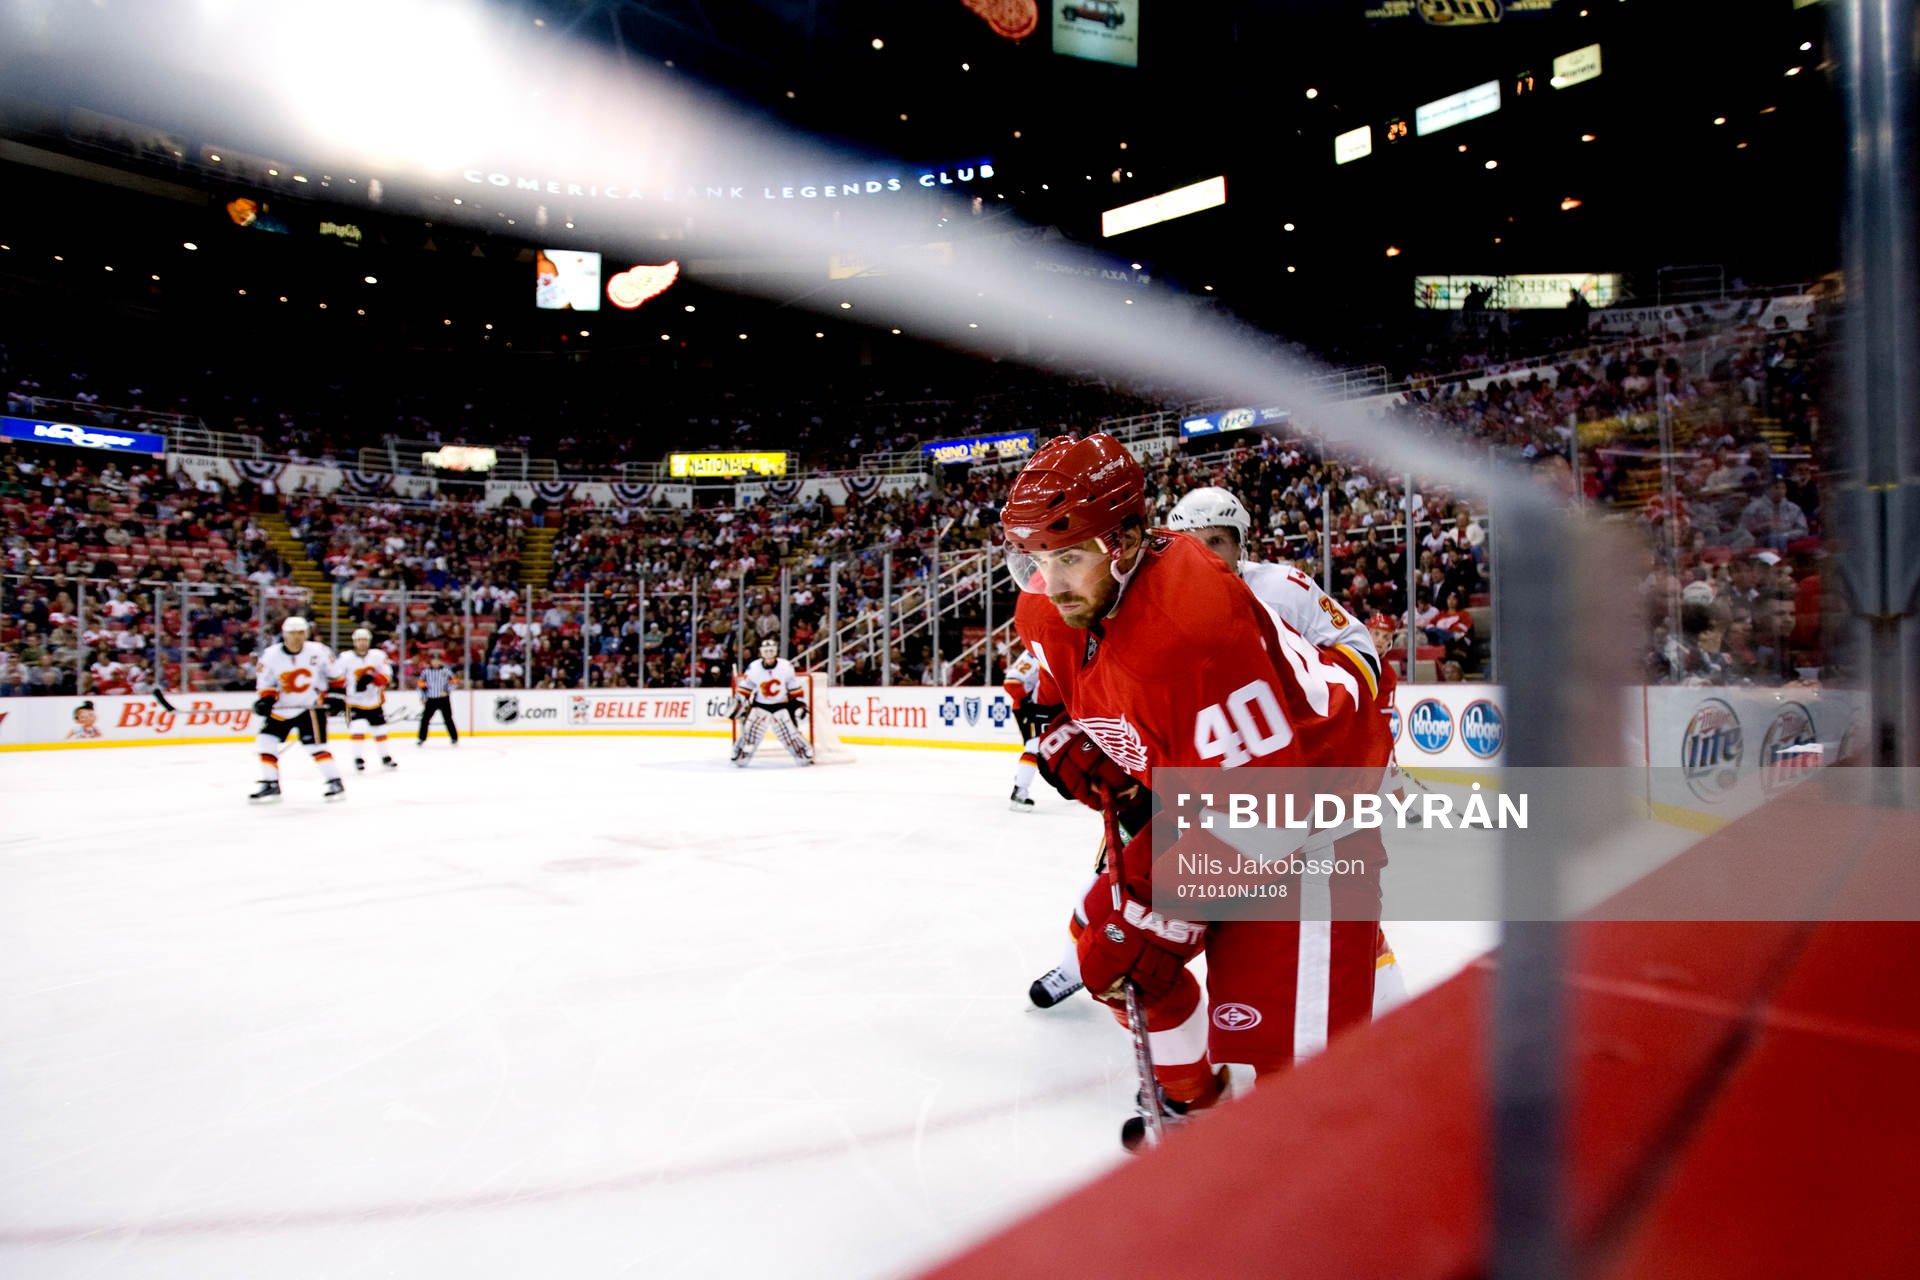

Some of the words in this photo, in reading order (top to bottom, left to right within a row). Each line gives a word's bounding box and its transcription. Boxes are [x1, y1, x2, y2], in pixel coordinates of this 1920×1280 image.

[463, 169, 643, 200] COMERICA
[764, 178, 901, 200] LEGENDS
[919, 163, 995, 188] CLUB
[689, 458, 748, 475] NATIONAL
[116, 702, 176, 733] Big
[186, 701, 253, 732] Boy
[594, 700, 648, 719] BELLE
[654, 700, 691, 718] TIRE
[867, 697, 928, 728] Farm
[1194, 679, 1293, 771] 40
[1414, 704, 1451, 749] Kroger
